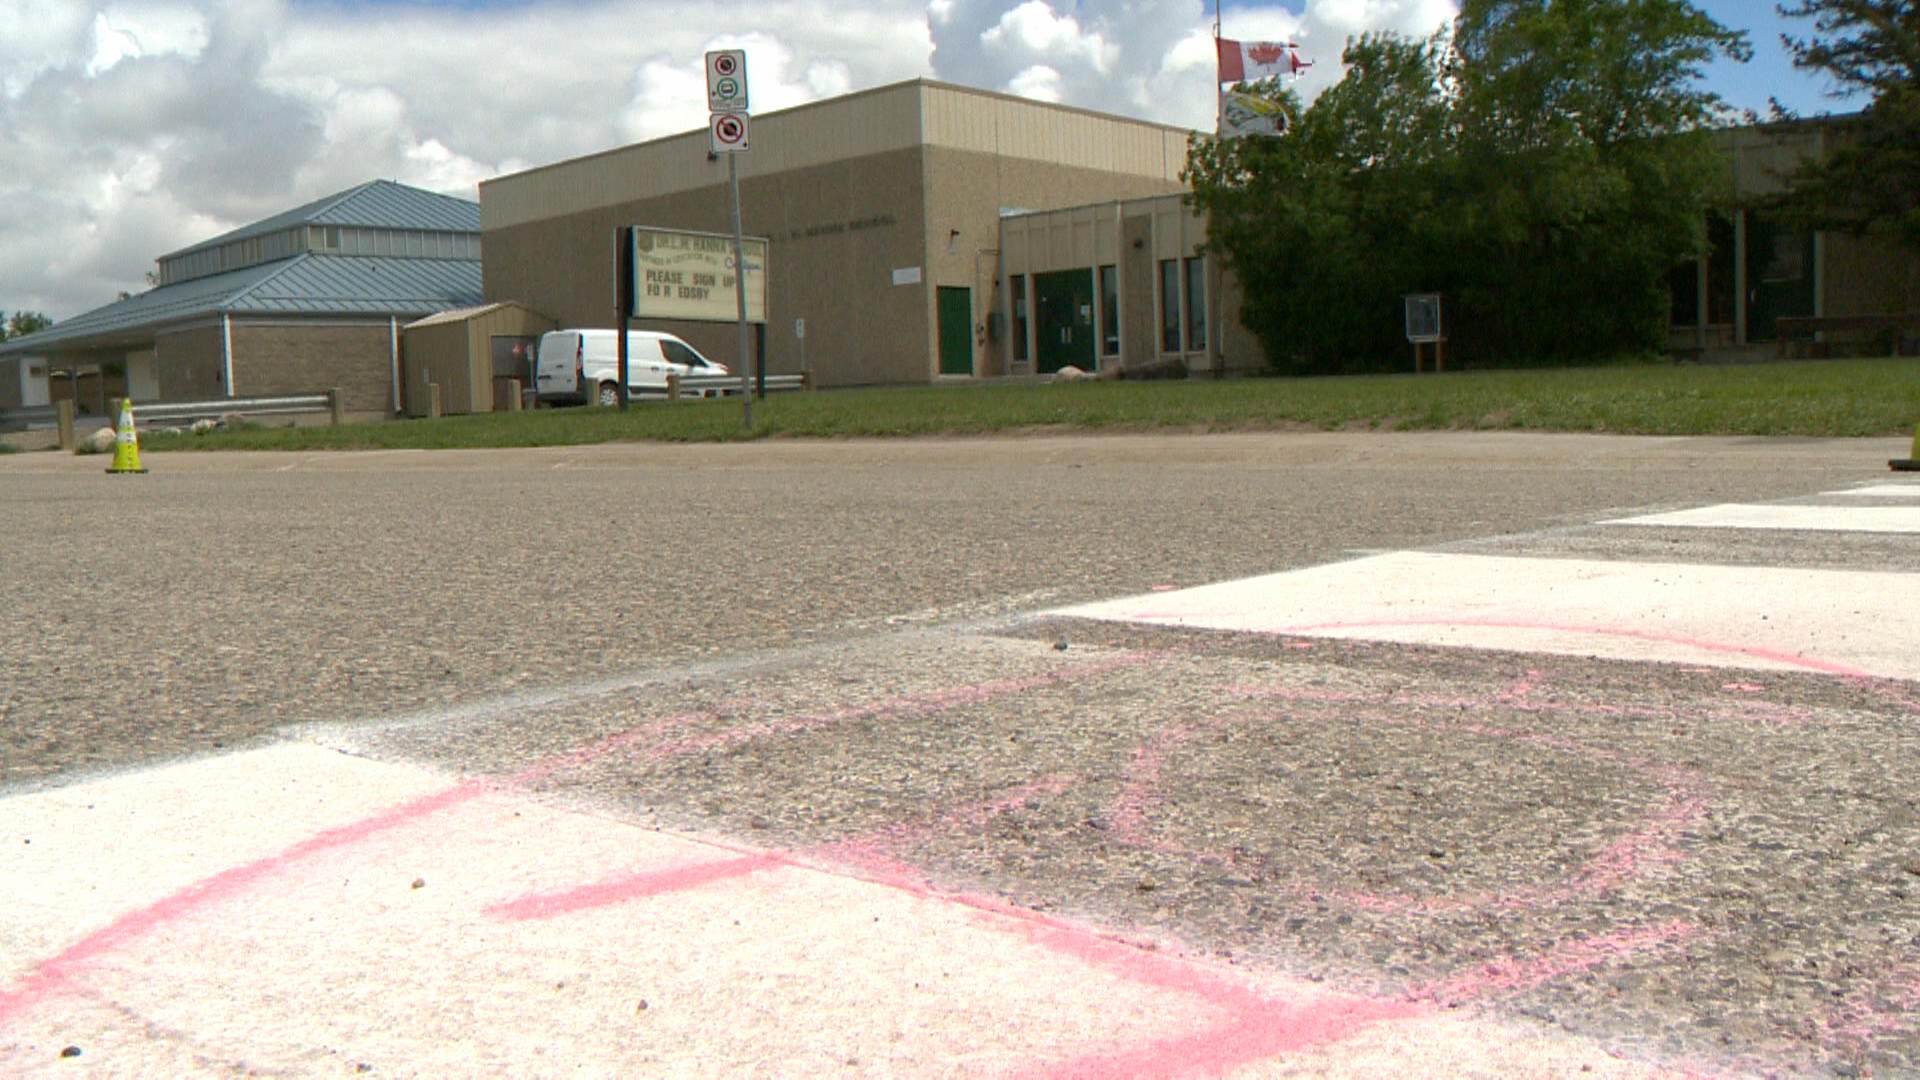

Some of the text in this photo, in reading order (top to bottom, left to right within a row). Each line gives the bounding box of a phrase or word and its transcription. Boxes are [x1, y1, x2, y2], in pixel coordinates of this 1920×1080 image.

[646, 269, 736, 288] PLEASE SIGN UP
[679, 286, 710, 299] EDSBY
